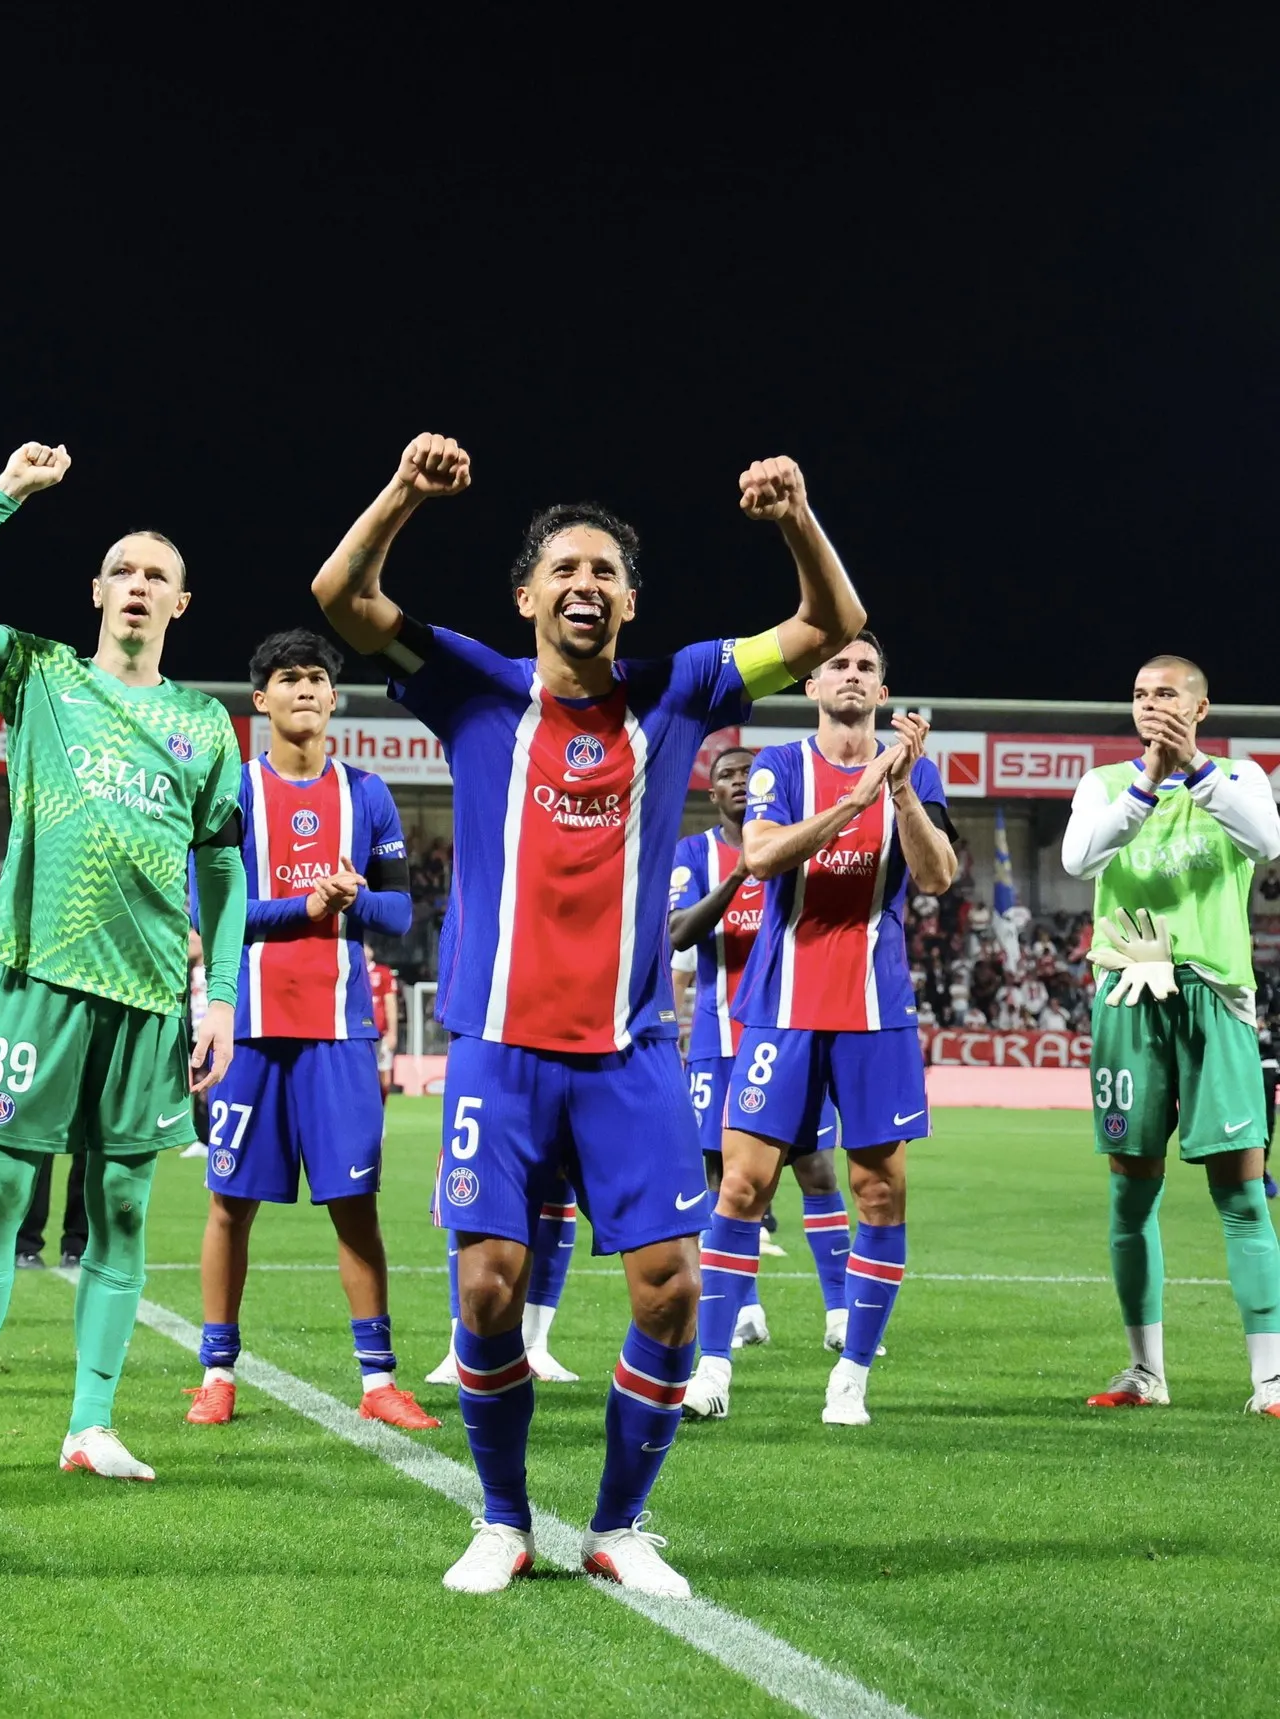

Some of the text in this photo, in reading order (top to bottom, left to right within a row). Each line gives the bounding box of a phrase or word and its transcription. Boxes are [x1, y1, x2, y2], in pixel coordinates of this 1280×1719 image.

[574, 737, 601, 749] PARIS
[66, 745, 171, 804] QATAR
[82, 779, 165, 820] AIRWAYS
[533, 785, 620, 815] QATAR
[552, 813, 621, 827] AIRWAYS
[276, 862, 332, 883] QATAR
[816, 849, 874, 868] QATAR
[830, 866, 872, 877] AIRWAYS
[748, 1042, 777, 1085] 8
[1095, 1067, 1134, 1111] 30
[210, 1100, 253, 1149] 27
[451, 1096, 483, 1160] 5
[451, 1169, 474, 1179] PARIS
